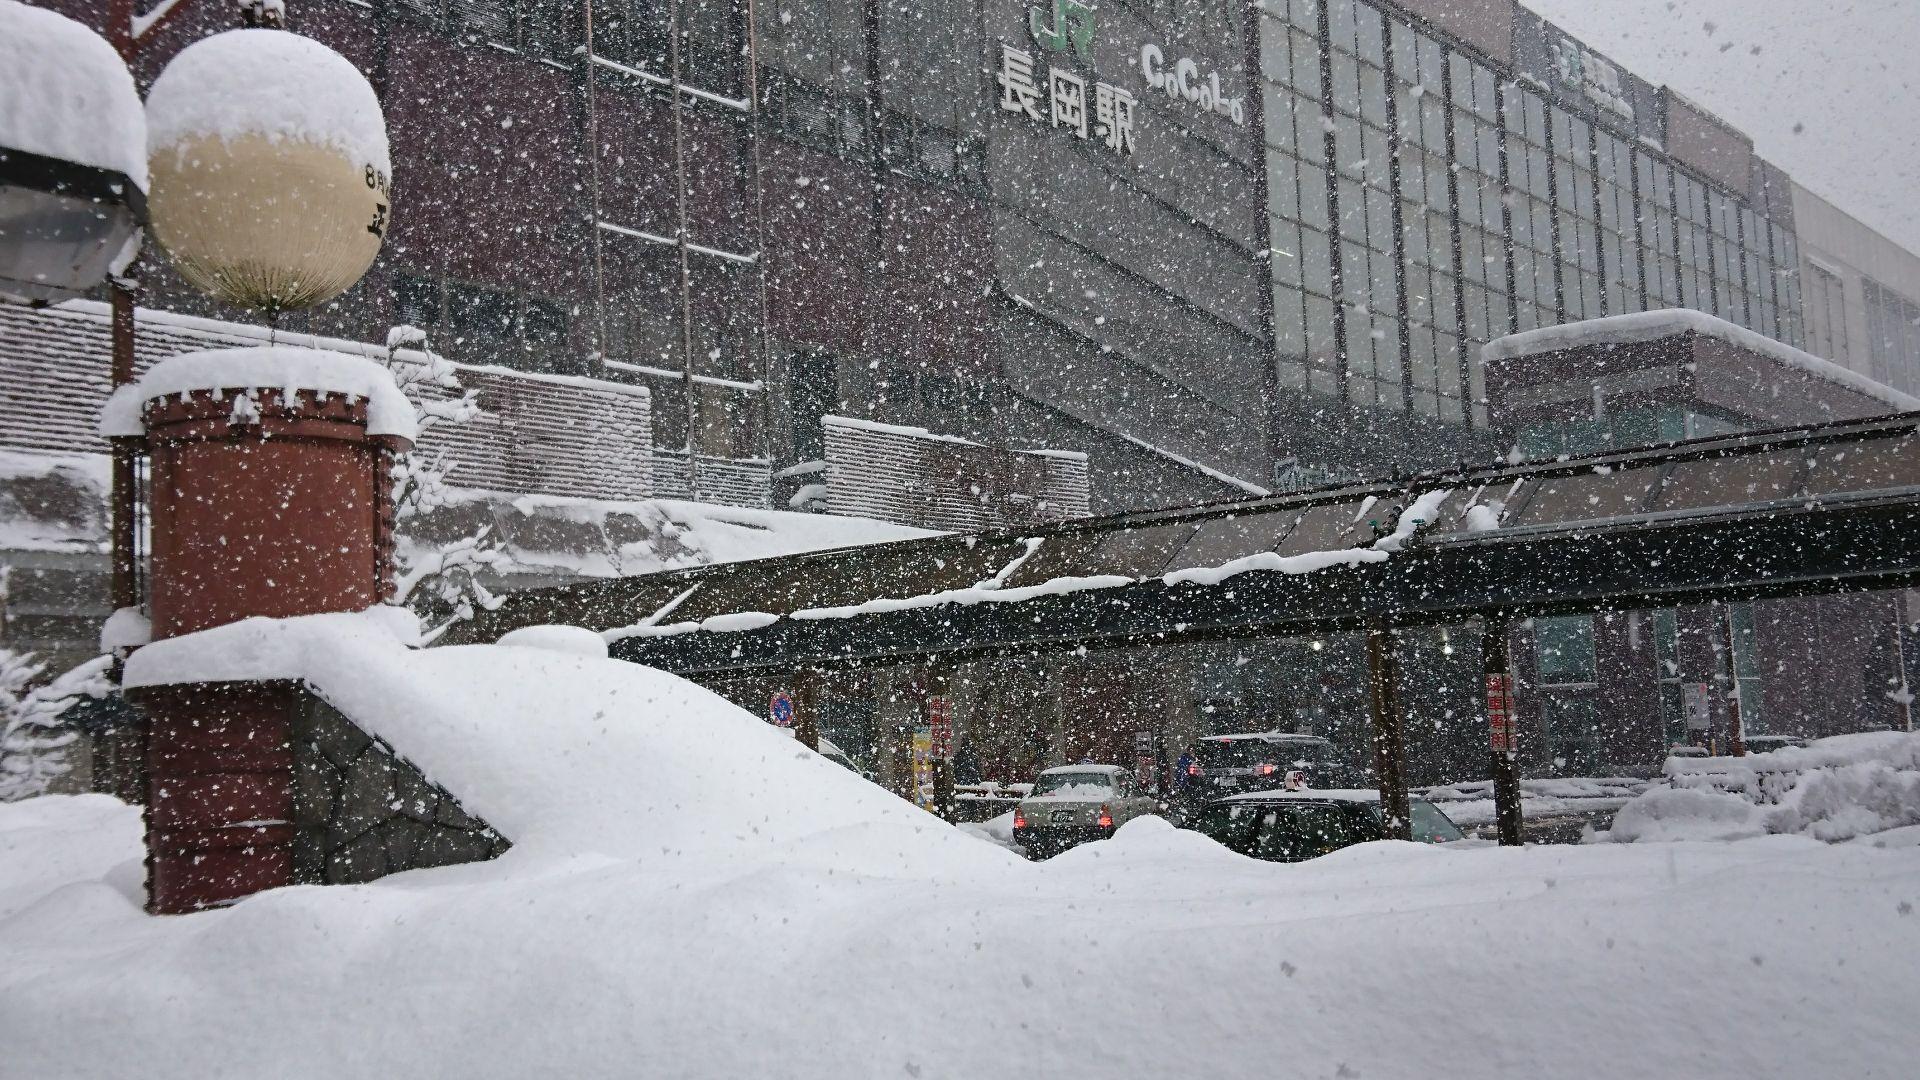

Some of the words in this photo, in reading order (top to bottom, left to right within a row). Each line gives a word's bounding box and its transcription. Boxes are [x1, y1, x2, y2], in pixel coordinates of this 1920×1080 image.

[1030, 0, 1096, 67] JR
[998, 44, 1138, 155] 長岡駅
[1141, 43, 1244, 125] CoCoLo
